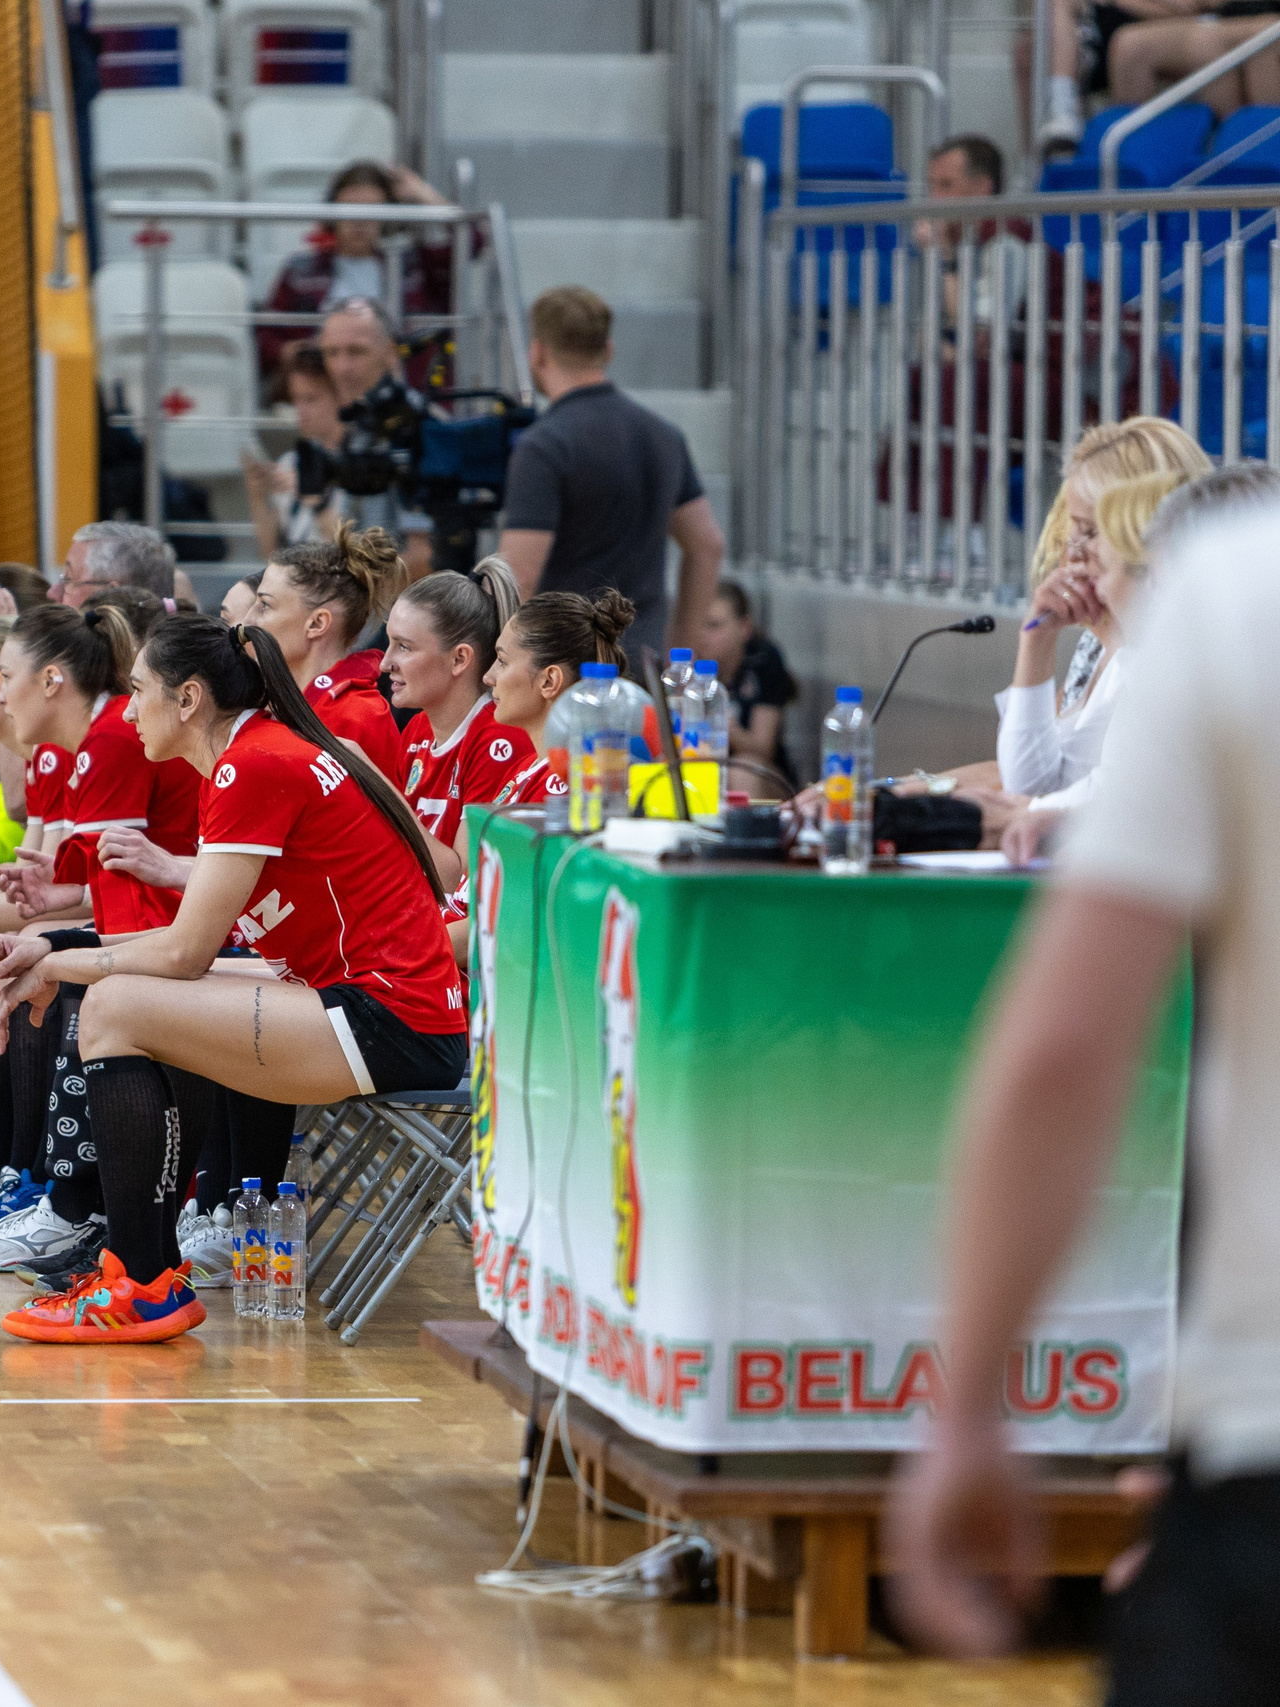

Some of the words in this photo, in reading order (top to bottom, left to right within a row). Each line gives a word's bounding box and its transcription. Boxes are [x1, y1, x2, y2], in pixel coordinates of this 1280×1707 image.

[245, 1228, 266, 1281] 202
[274, 1241, 293, 1286] 202
[730, 1345, 1124, 1419] BELAUS
